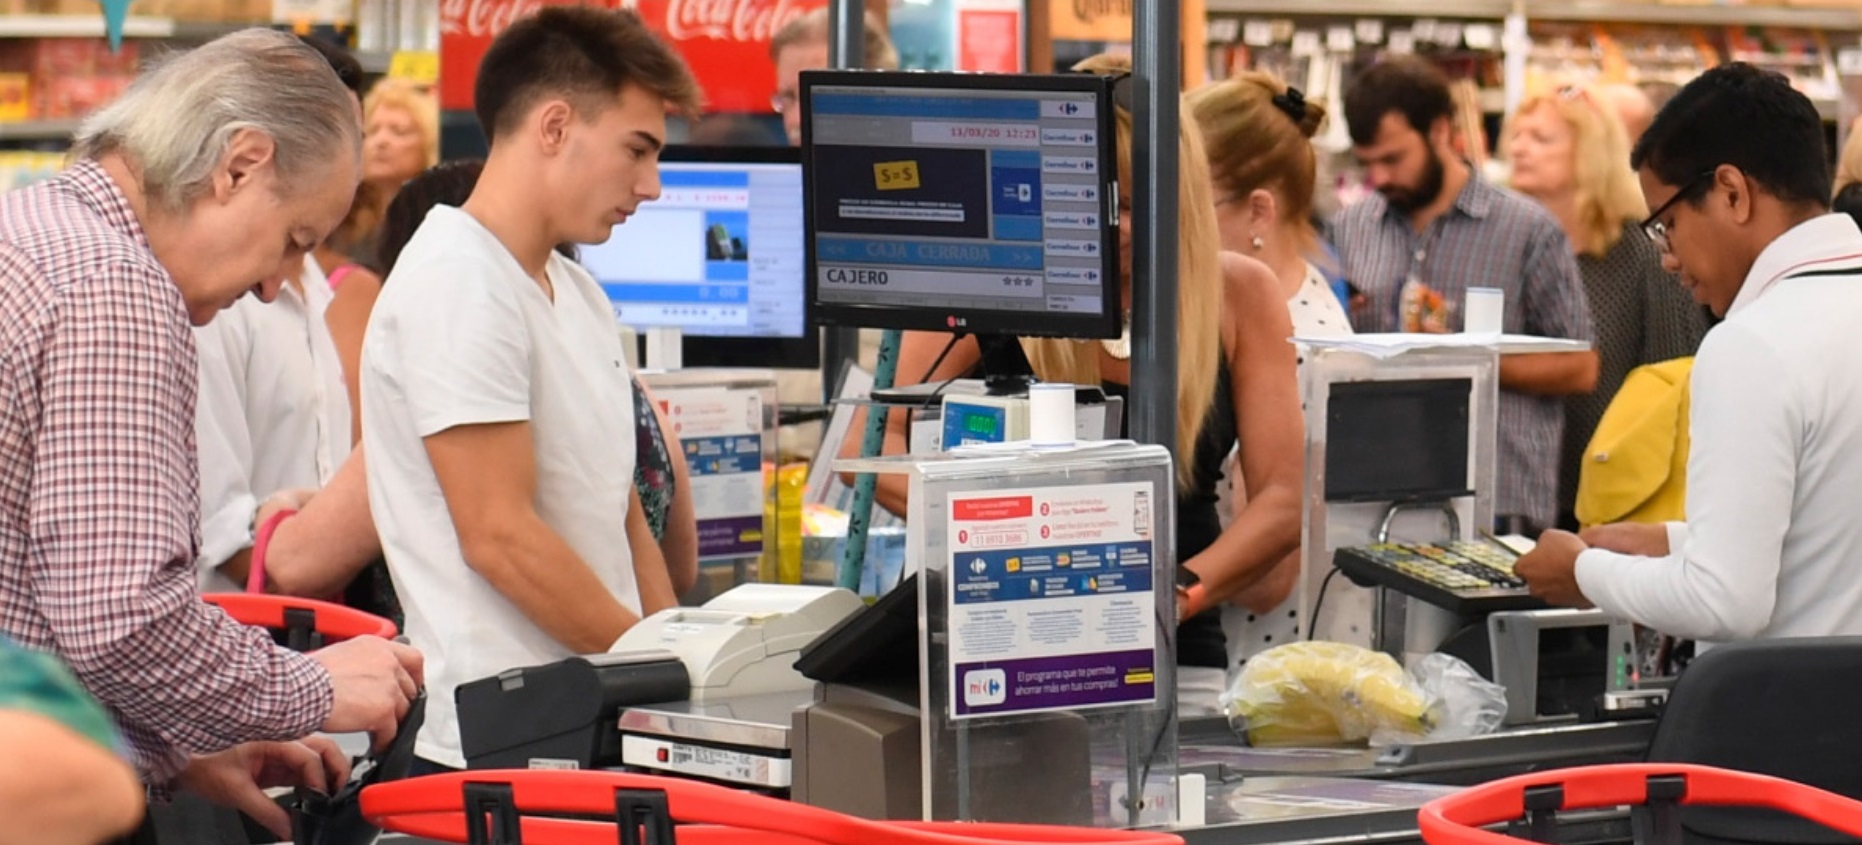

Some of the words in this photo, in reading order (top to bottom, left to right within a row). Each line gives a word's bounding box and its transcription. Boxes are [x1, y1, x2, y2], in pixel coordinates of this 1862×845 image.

[1006, 128, 1037, 140] 12:23
[866, 242, 907, 258] CAJA
[918, 245, 991, 261] CERRADA
[827, 269, 888, 285] CAJERO
[956, 318, 967, 326] LG
[1025, 671, 1062, 684] programa
[1063, 671, 1078, 681] que
[1078, 669, 1087, 678] te
[1087, 666, 1116, 679] permite
[970, 682, 982, 694] mi
[1015, 685, 1043, 696] ahorrar
[1060, 684, 1071, 692] en
[1071, 681, 1082, 691] tus
